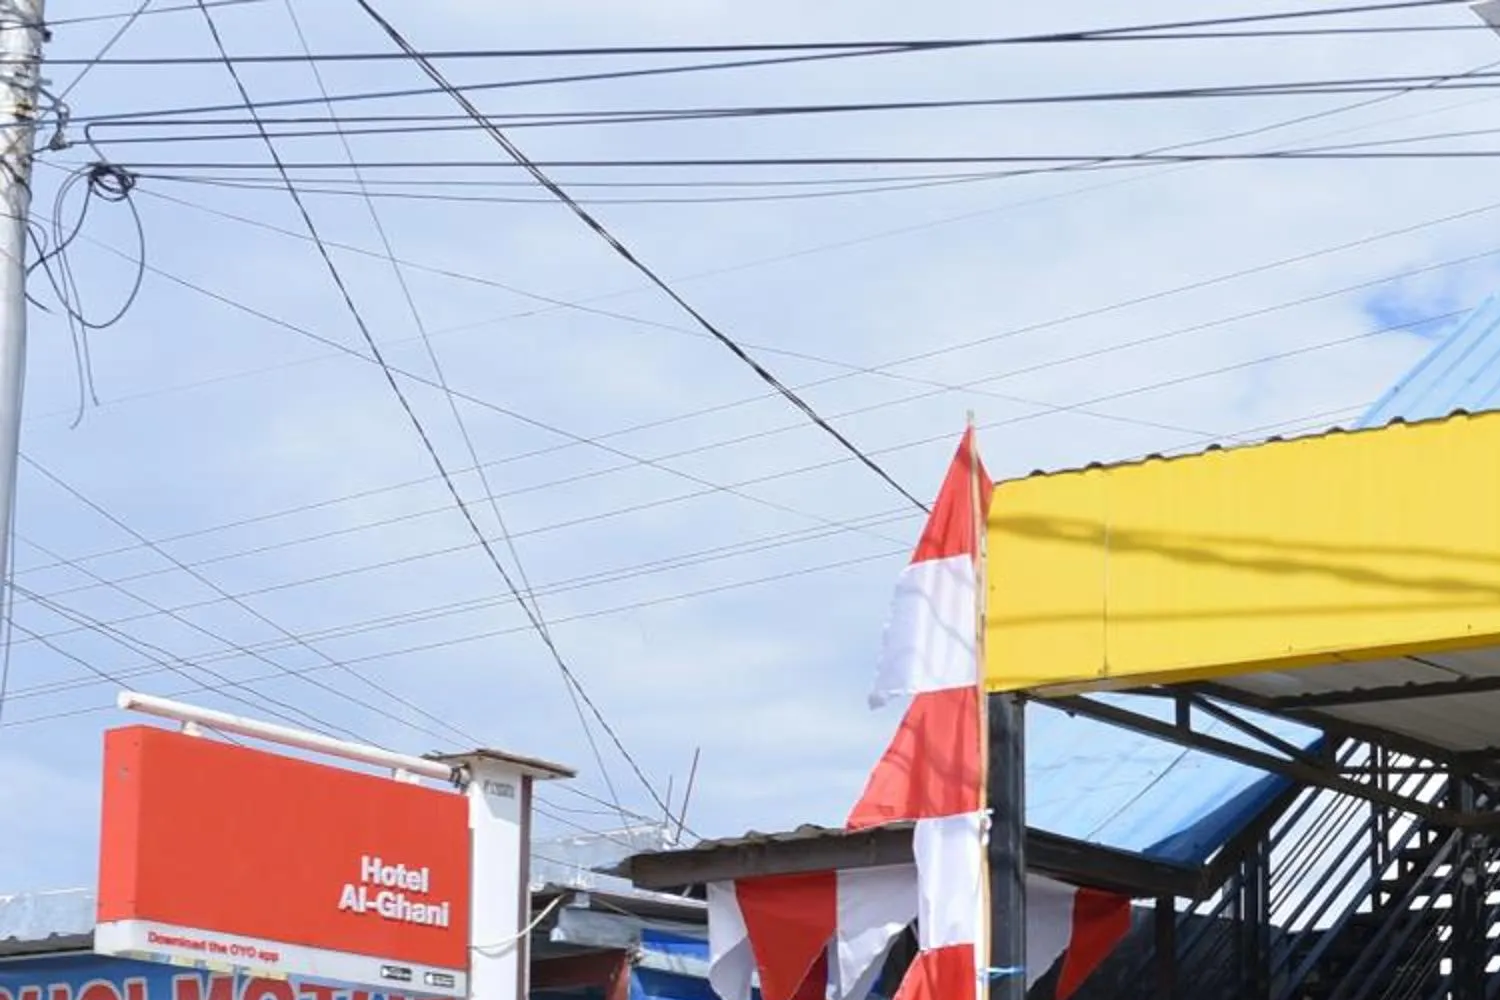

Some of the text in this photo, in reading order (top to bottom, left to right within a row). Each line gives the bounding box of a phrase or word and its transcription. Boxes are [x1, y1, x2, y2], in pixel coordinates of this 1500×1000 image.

[360, 855, 429, 893] Hotel
[337, 883, 450, 928] Al-Ghani
[208, 940, 228, 955] the
[229, 943, 257, 958] OYO
